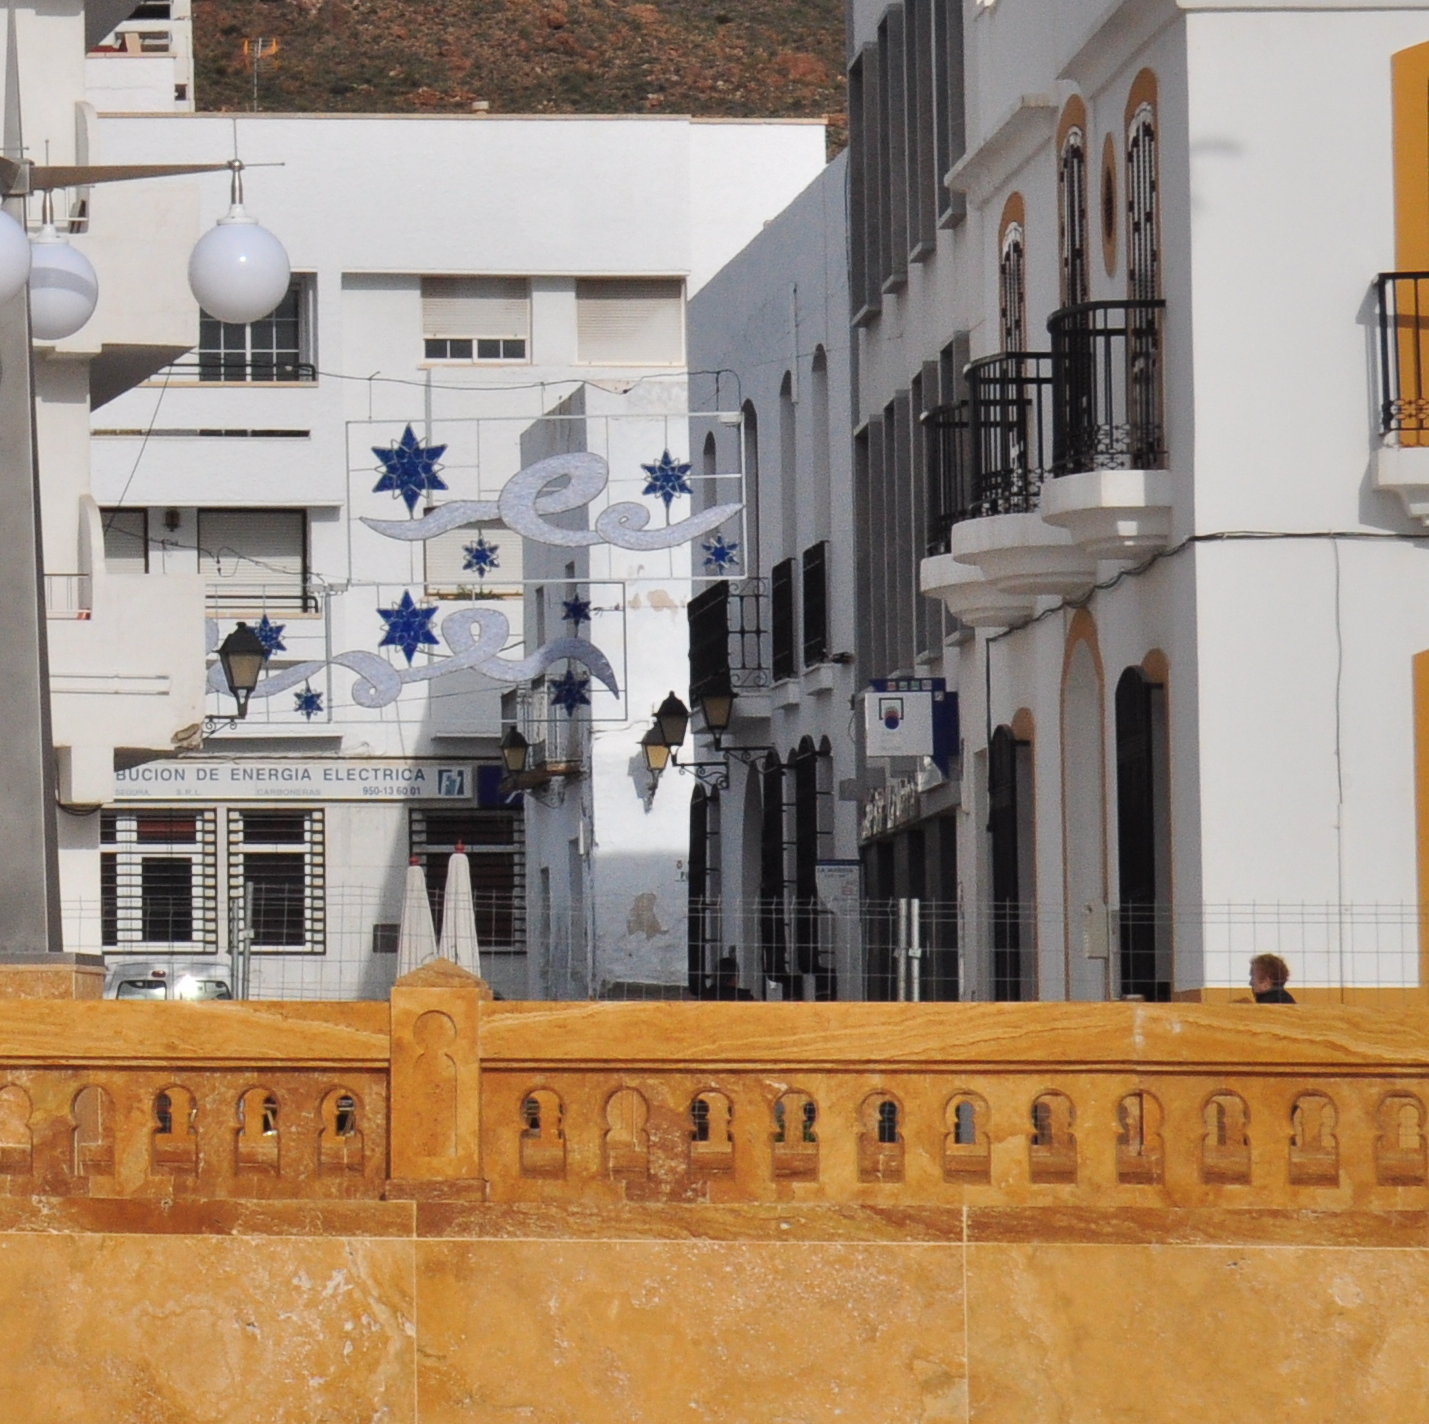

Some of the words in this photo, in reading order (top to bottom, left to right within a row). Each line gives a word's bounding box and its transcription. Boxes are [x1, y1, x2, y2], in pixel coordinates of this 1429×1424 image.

[196, 768, 220, 781] DE
[230, 767, 312, 781] ENERGIA
[323, 767, 426, 781] ELECTRICA
